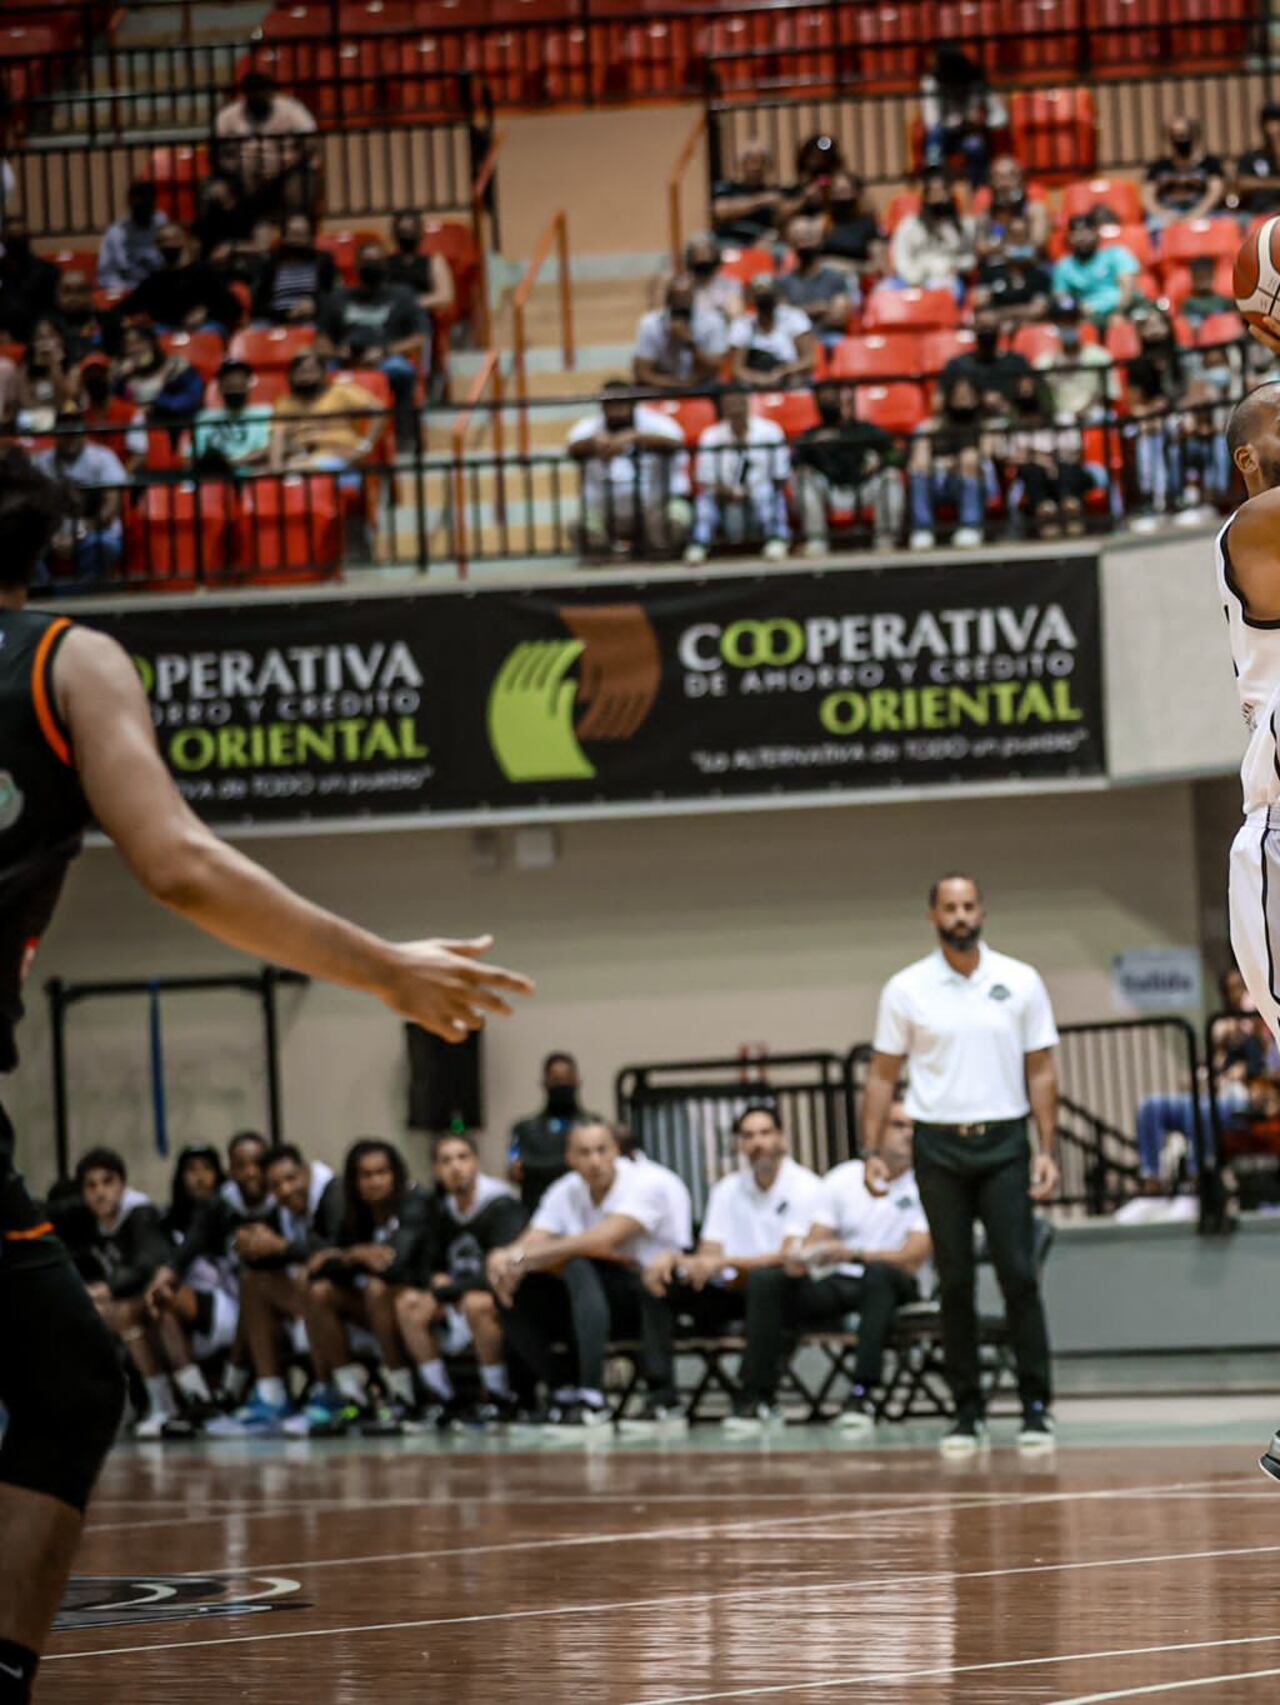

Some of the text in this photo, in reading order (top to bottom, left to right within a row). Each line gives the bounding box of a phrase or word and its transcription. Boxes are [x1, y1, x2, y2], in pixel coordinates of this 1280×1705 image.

[677, 604, 1079, 672] COOPERATIVA
[684, 670, 726, 699] DE
[740, 663, 883, 695] AHORRO
[897, 660, 918, 684] Y
[246, 698, 265, 721] Y
[819, 680, 1082, 735] ORIENTAL
[171, 716, 430, 771] ORIENTAL
